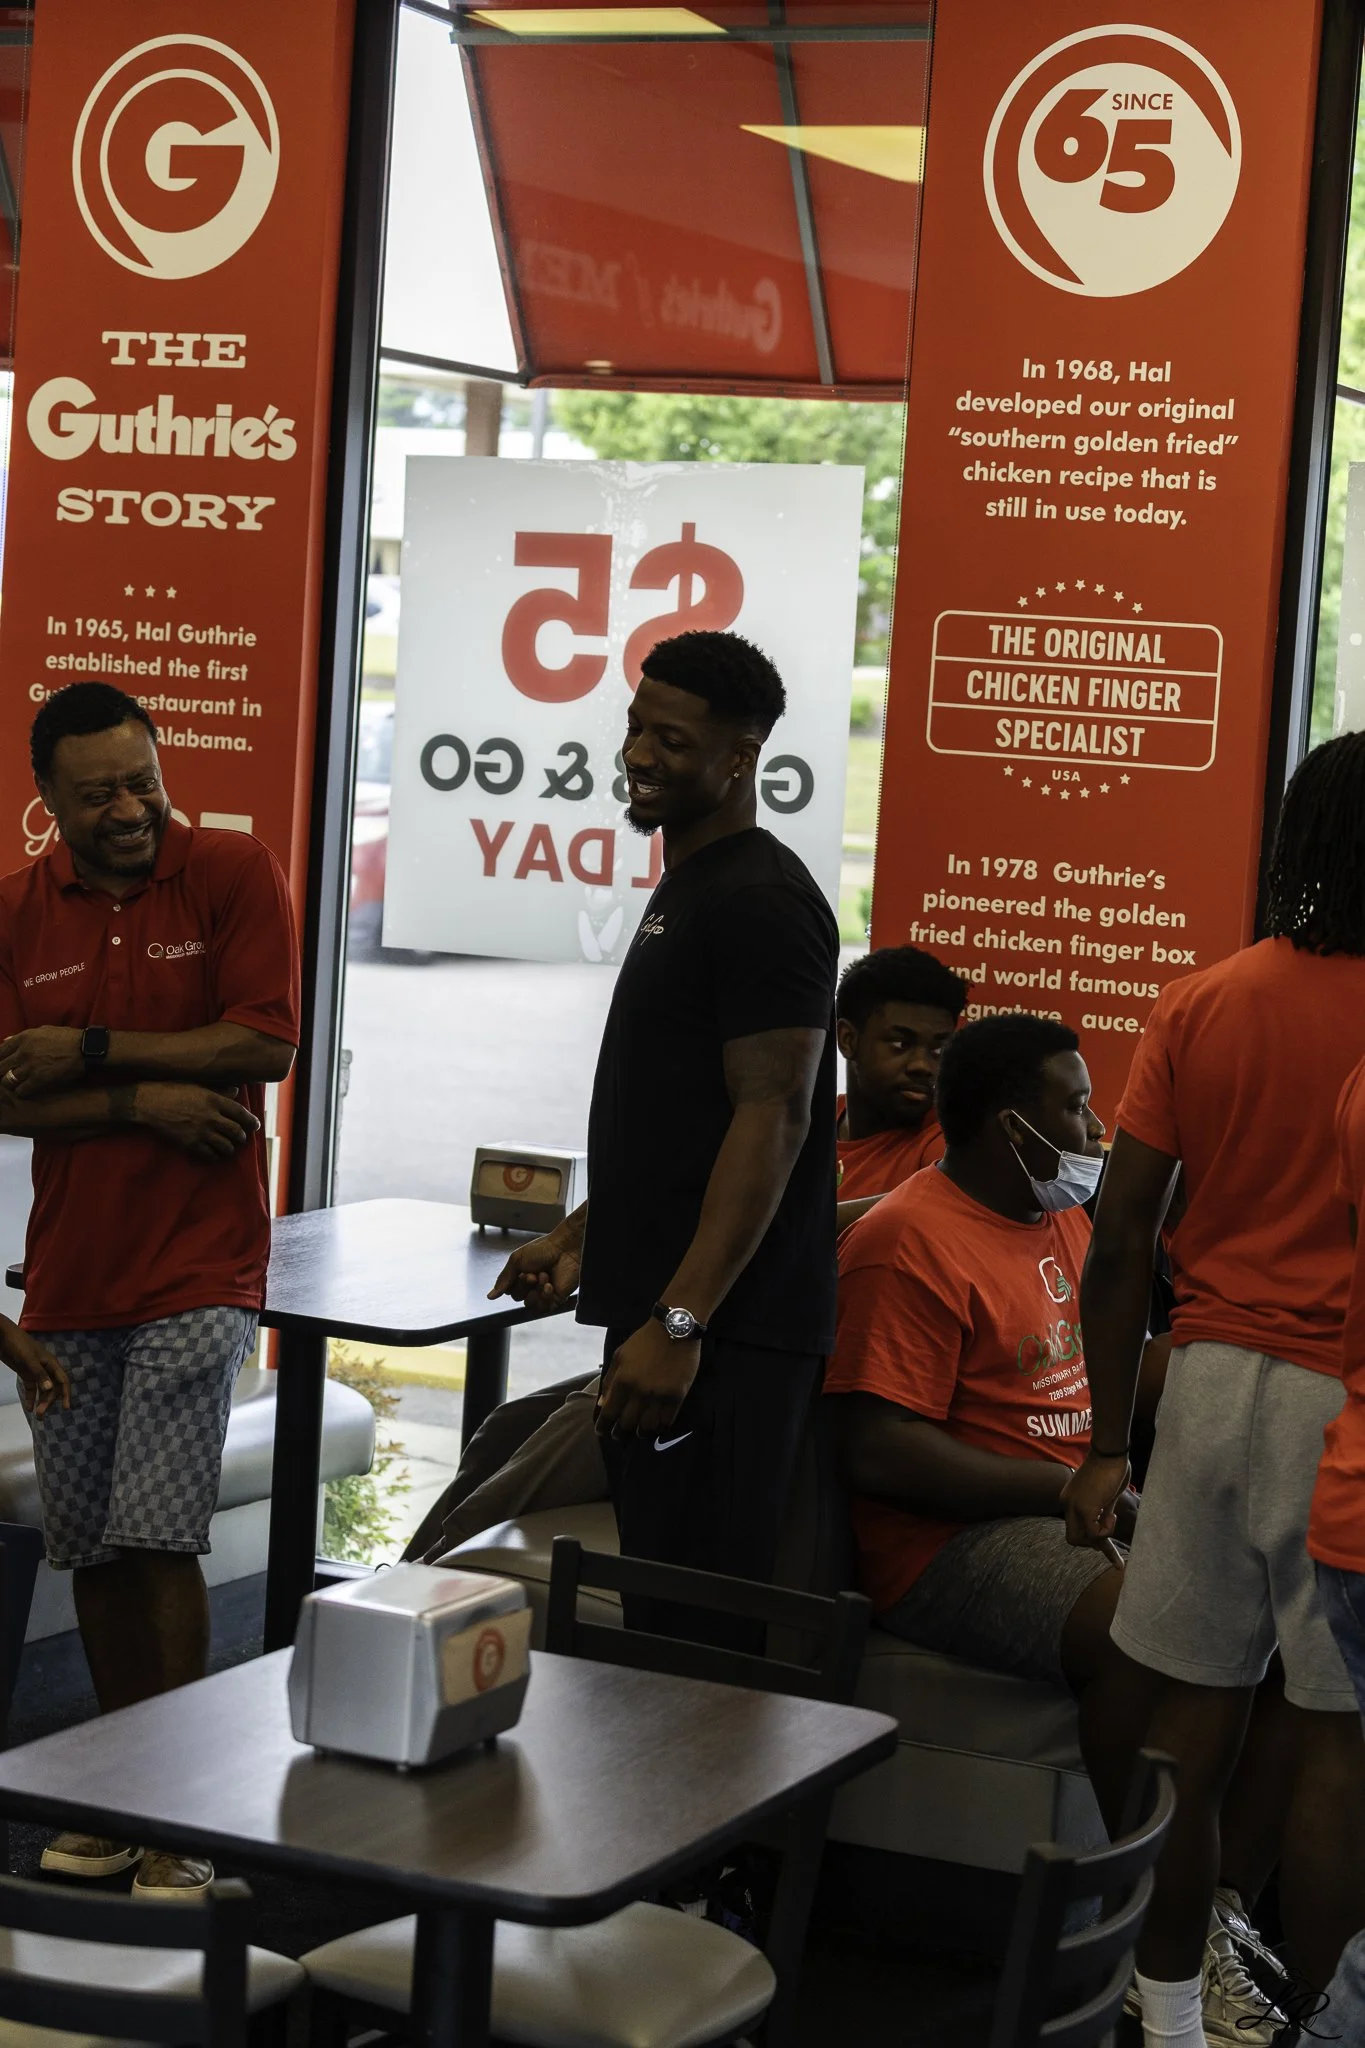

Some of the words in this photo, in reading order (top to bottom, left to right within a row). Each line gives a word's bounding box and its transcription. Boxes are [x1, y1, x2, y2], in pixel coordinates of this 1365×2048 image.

[1112, 93, 1174, 111] SINCE
[1034, 88, 1176, 214] 65
[101, 330, 247, 369] THE
[1022, 357, 1046, 379] In
[1055, 359, 1121, 385] 1968,
[1128, 360, 1172, 383] Hal
[26, 376, 298, 462] Guthrie's
[955, 389, 1083, 420] developed
[1089, 400, 1132, 417] our
[1137, 396, 1235, 424] original
[947, 426, 1067, 450] "southern
[1073, 429, 1159, 456] golden
[1165, 431, 1240, 456] fried"
[962, 459, 1052, 485] chicken
[1059, 465, 1134, 492] recipe
[1140, 466, 1191, 490] that
[1197, 468, 1217, 491] is
[56, 486, 276, 531] STORY
[985, 496, 1028, 518] still
[1034, 497, 1058, 520] in
[1065, 505, 1107, 522] use
[1113, 501, 1187, 531] today.
[47, 615, 67, 636] In
[74, 617, 129, 643] 1965,
[135, 621, 172, 642] Hal
[177, 623, 257, 647] Guthrie
[988, 624, 1037, 657] THE
[1043, 627, 1166, 664] ORIGINAL
[45, 651, 162, 676] established
[167, 657, 201, 679] the
[206, 659, 249, 682] first
[129, 693, 236, 716] estaurant
[242, 696, 262, 718] in
[966, 669, 1081, 707] CHICKEN
[1087, 677, 1182, 713] FINGER
[995, 717, 1146, 757] SPECIALIST
[1051, 769, 1081, 782] USA
[947, 853, 971, 875] In
[980, 856, 1038, 881] 1978
[1052, 861, 1166, 891] Guthrie's
[922, 888, 1047, 917] pioneered
[1053, 897, 1092, 923] the
[1099, 902, 1186, 928] golden
[166, 944, 184, 955] Oak
[909, 920, 966, 946] fried
[972, 927, 1063, 954] chicken
[1069, 934, 1145, 964] finger
[1151, 940, 1197, 966] box
[23, 977, 34, 988] WE
[35, 971, 58, 984] GROW
[59, 961, 86, 978] PEOPLE
[949, 962, 987, 984] nd
[993, 967, 1062, 990] world
[1068, 970, 1160, 999] famous
[1032, 1368, 1072, 1391] MISSIONARY
[1026, 1407, 1092, 1437] SUMME
